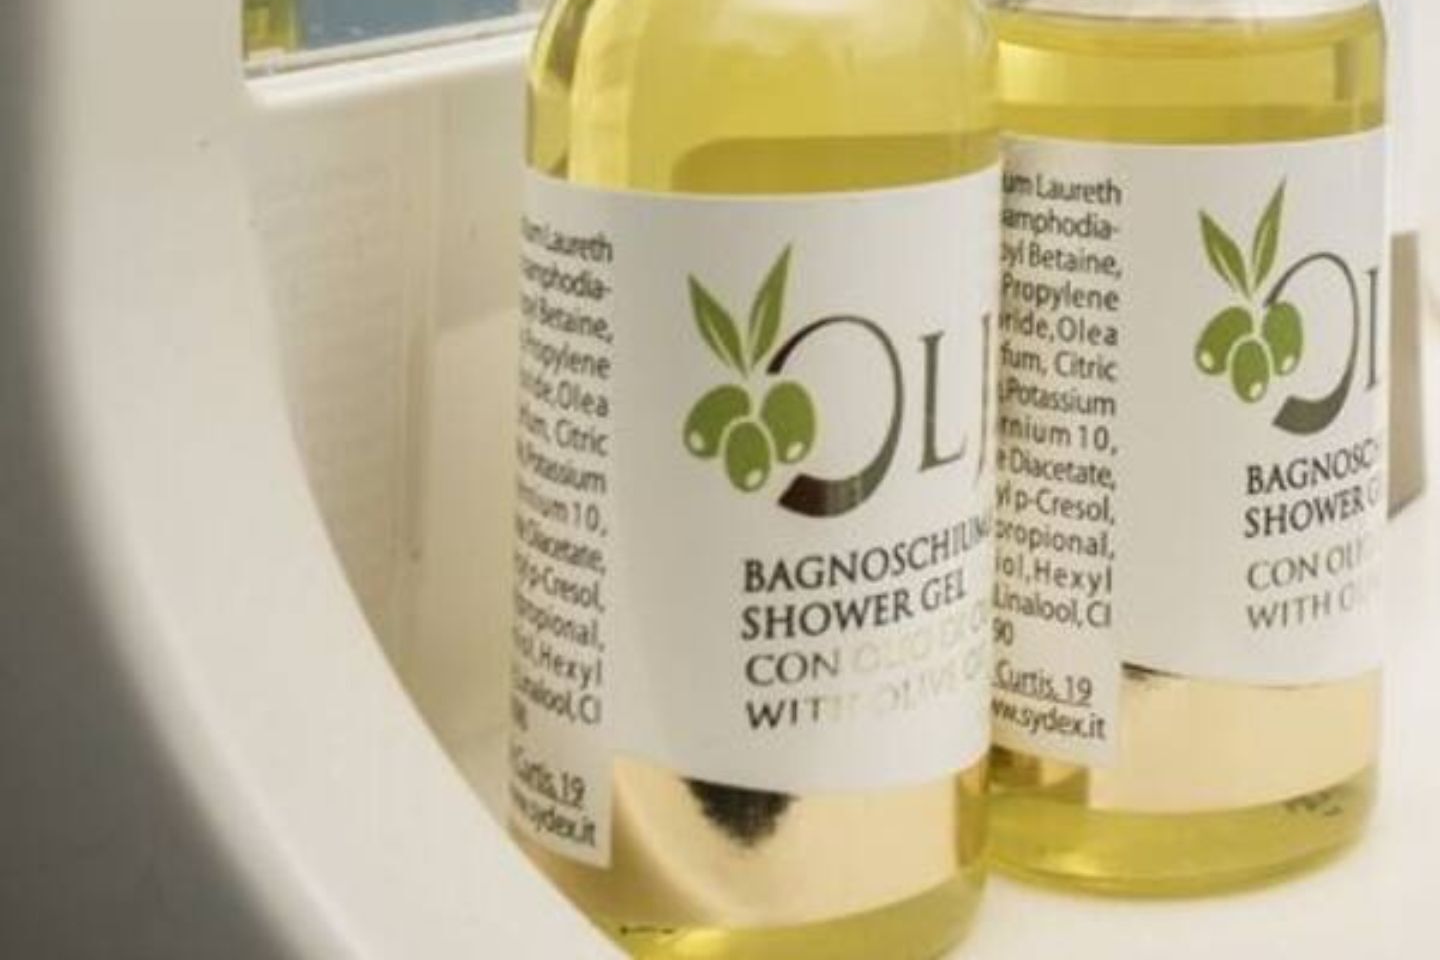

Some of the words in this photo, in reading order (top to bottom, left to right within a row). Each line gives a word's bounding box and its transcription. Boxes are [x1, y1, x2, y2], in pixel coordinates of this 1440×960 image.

[1035, 172, 1122, 205] Laureth
[1029, 242, 1122, 280] Betaine,
[1002, 271, 1121, 312] Propylene
[1054, 349, 1119, 382] Citric
[1078, 424, 1118, 456] 10,
[1010, 446, 1117, 491] Diacetate,
[1015, 488, 1116, 526] p-Cresol,
[1244, 484, 1365, 539] SHOWER
[1247, 551, 1320, 592] CON
[741, 589, 915, 641] SHOWER
[921, 568, 967, 613] GEL
[1246, 589, 1331, 631] WITH
[745, 648, 840, 688] CON
[1065, 675, 1094, 708] 19
